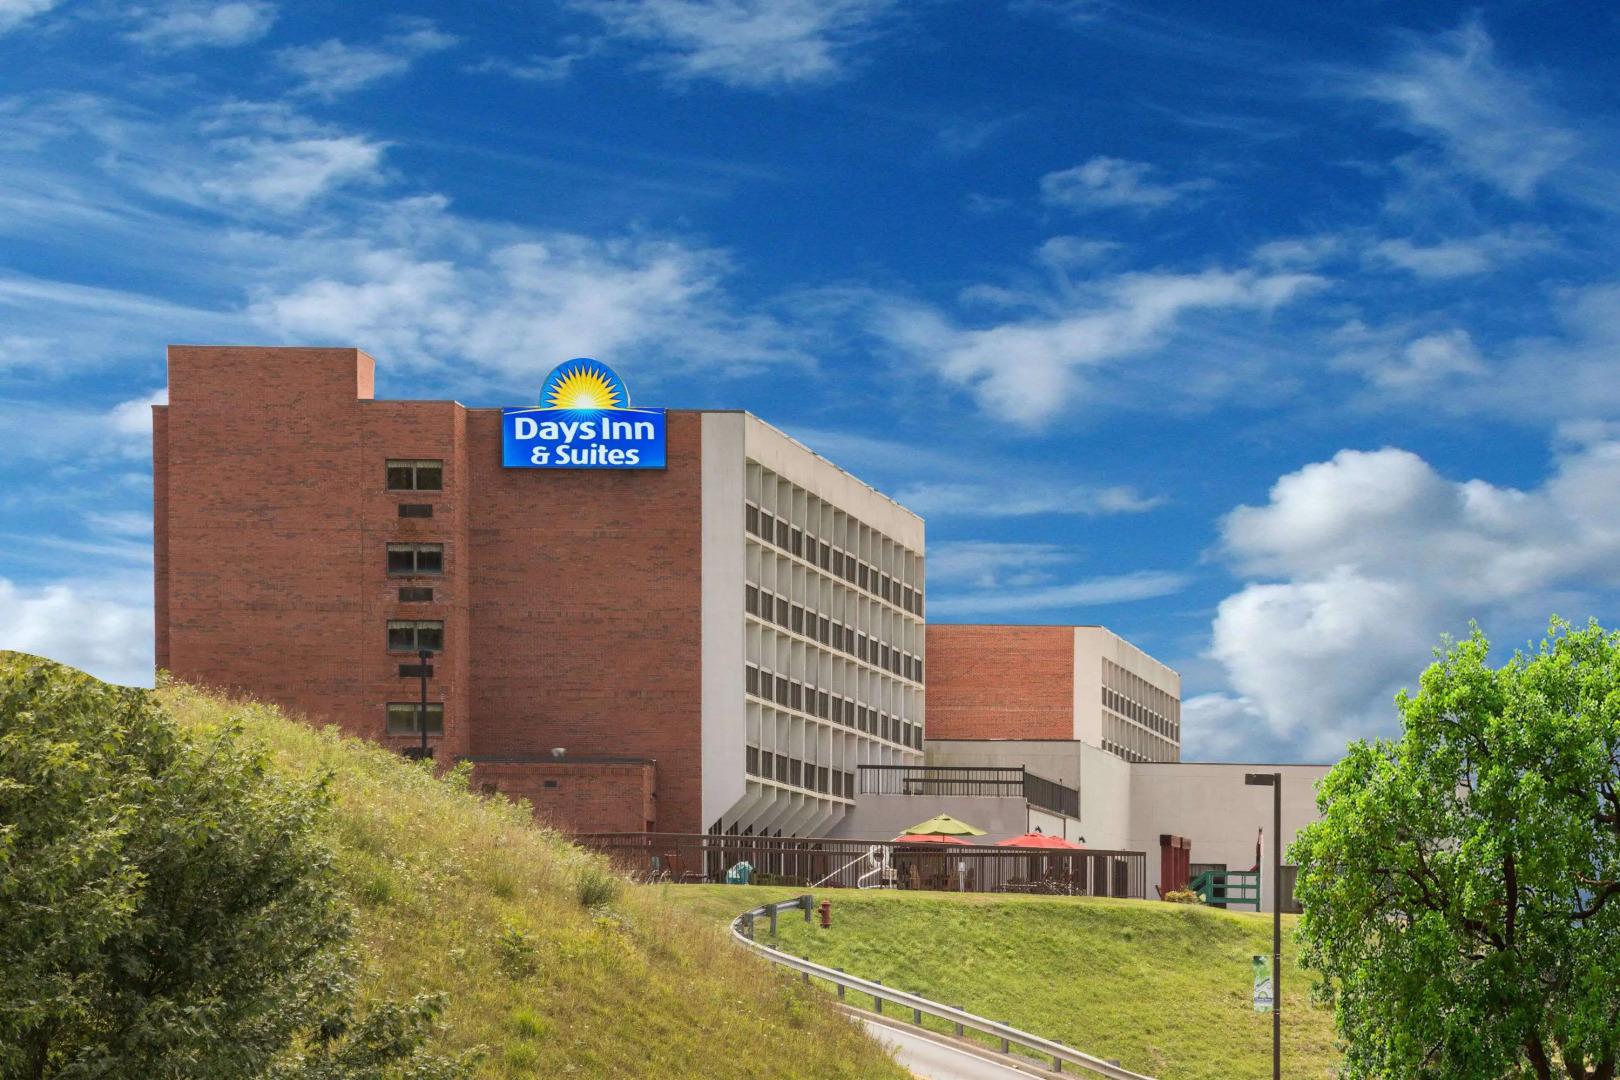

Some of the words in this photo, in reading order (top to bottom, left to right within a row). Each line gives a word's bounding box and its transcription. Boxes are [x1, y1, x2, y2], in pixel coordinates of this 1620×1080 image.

[514, 417, 596, 444] Days
[601, 417, 655, 440] Inn
[530, 446, 550, 465] &
[555, 443, 640, 465] Suites
